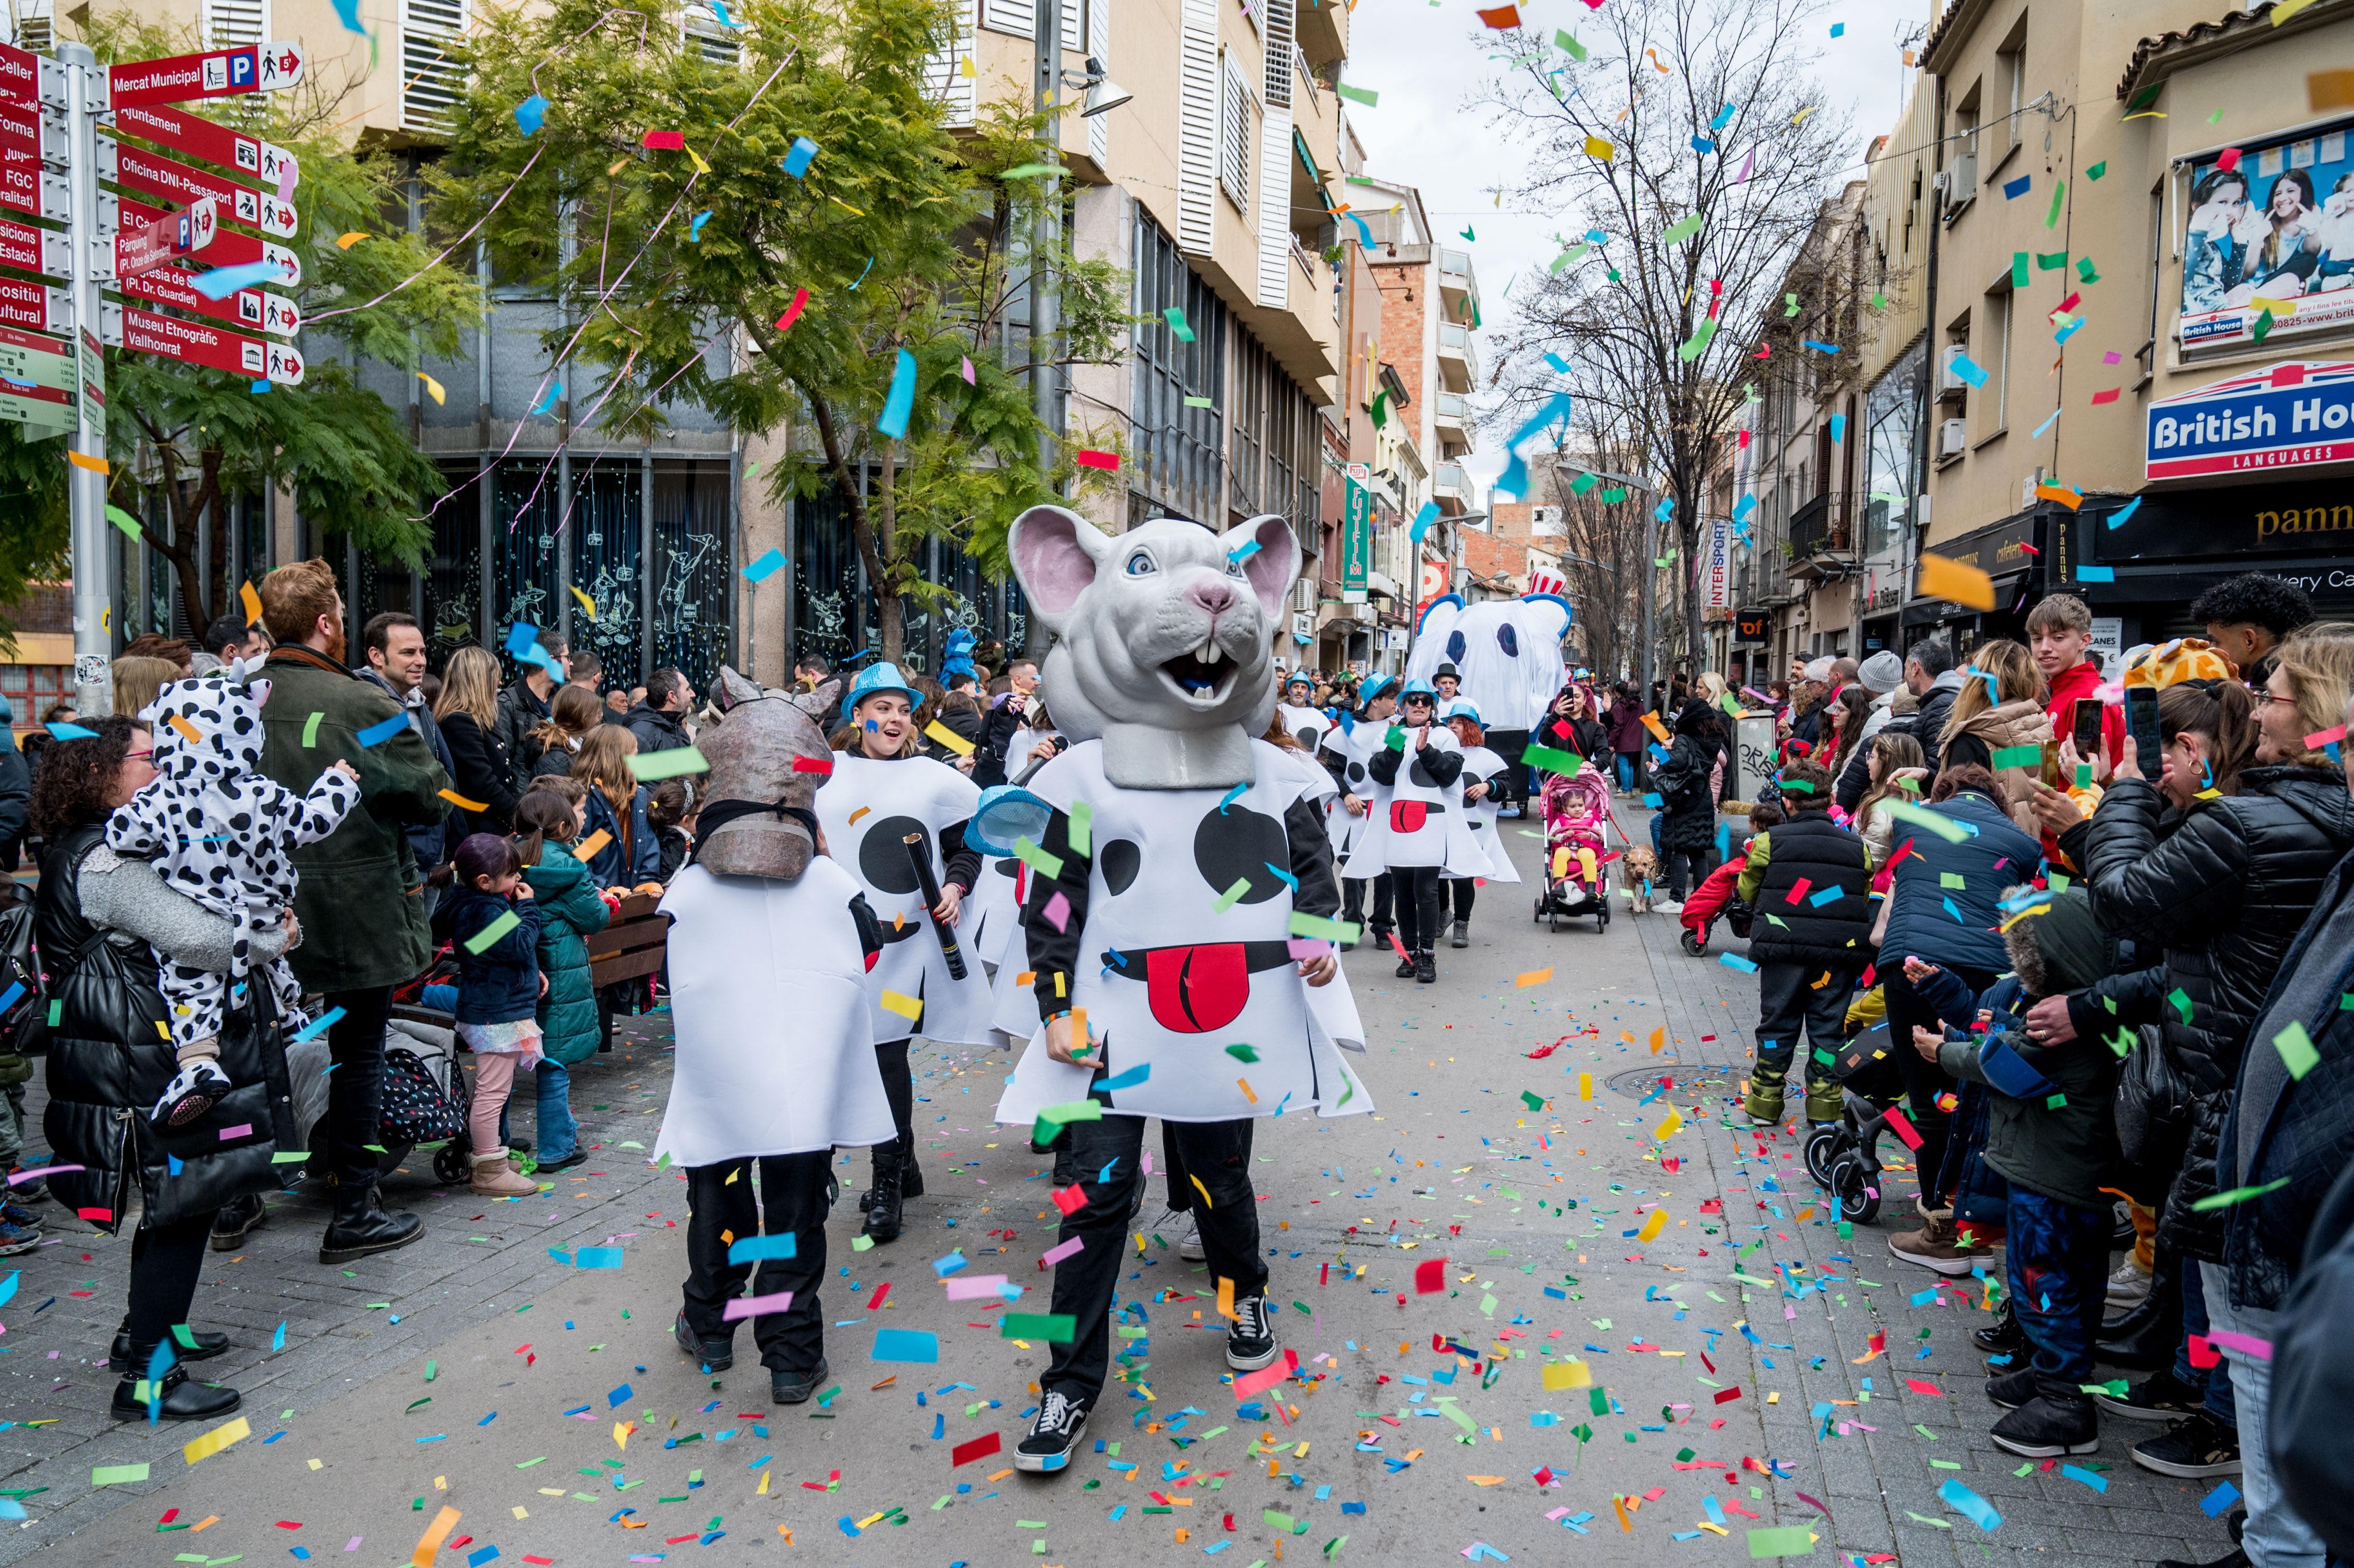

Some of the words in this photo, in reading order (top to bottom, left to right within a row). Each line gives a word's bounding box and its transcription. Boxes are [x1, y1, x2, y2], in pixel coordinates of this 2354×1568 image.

[114, 75, 149, 93] Mercat
[151, 67, 200, 88] Municipal
[233, 56, 250, 83] P
[6, 169, 32, 189] FGC
[122, 157, 159, 181] Oficina
[161, 170, 231, 205] DNI-Passaport
[123, 211, 133, 226] El
[180, 218, 188, 246] P
[120, 234, 147, 253] Pàrquing
[120, 258, 130, 273] (Pl.
[130, 256, 143, 269] Onze
[143, 254, 149, 264] de
[150, 242, 171, 262] Setembre)
[126, 277, 141, 291] (Pl.
[143, 281, 155, 295] Dr.
[157, 285, 197, 308] Guardiet)
[172, 272, 185, 285] de
[0, 286, 40, 304] ositiu
[128, 312, 163, 333] Museu
[166, 321, 217, 346] Etnogràfic
[2185, 325, 2212, 337] British
[2214, 321, 2241, 331] House
[128, 331, 181, 356] Vallhonrat
[2155, 406, 2276, 449] British
[2292, 398, 2354, 433] Ho
[2233, 447, 2332, 468] LANGUAGES
[1350, 487, 1362, 576] FUJIFILM
[2253, 505, 2354, 546] pann
[1711, 522, 1725, 605] INTERSPORT
[1997, 535, 2023, 564] cafeteria
[2109, 654, 2115, 662] €
